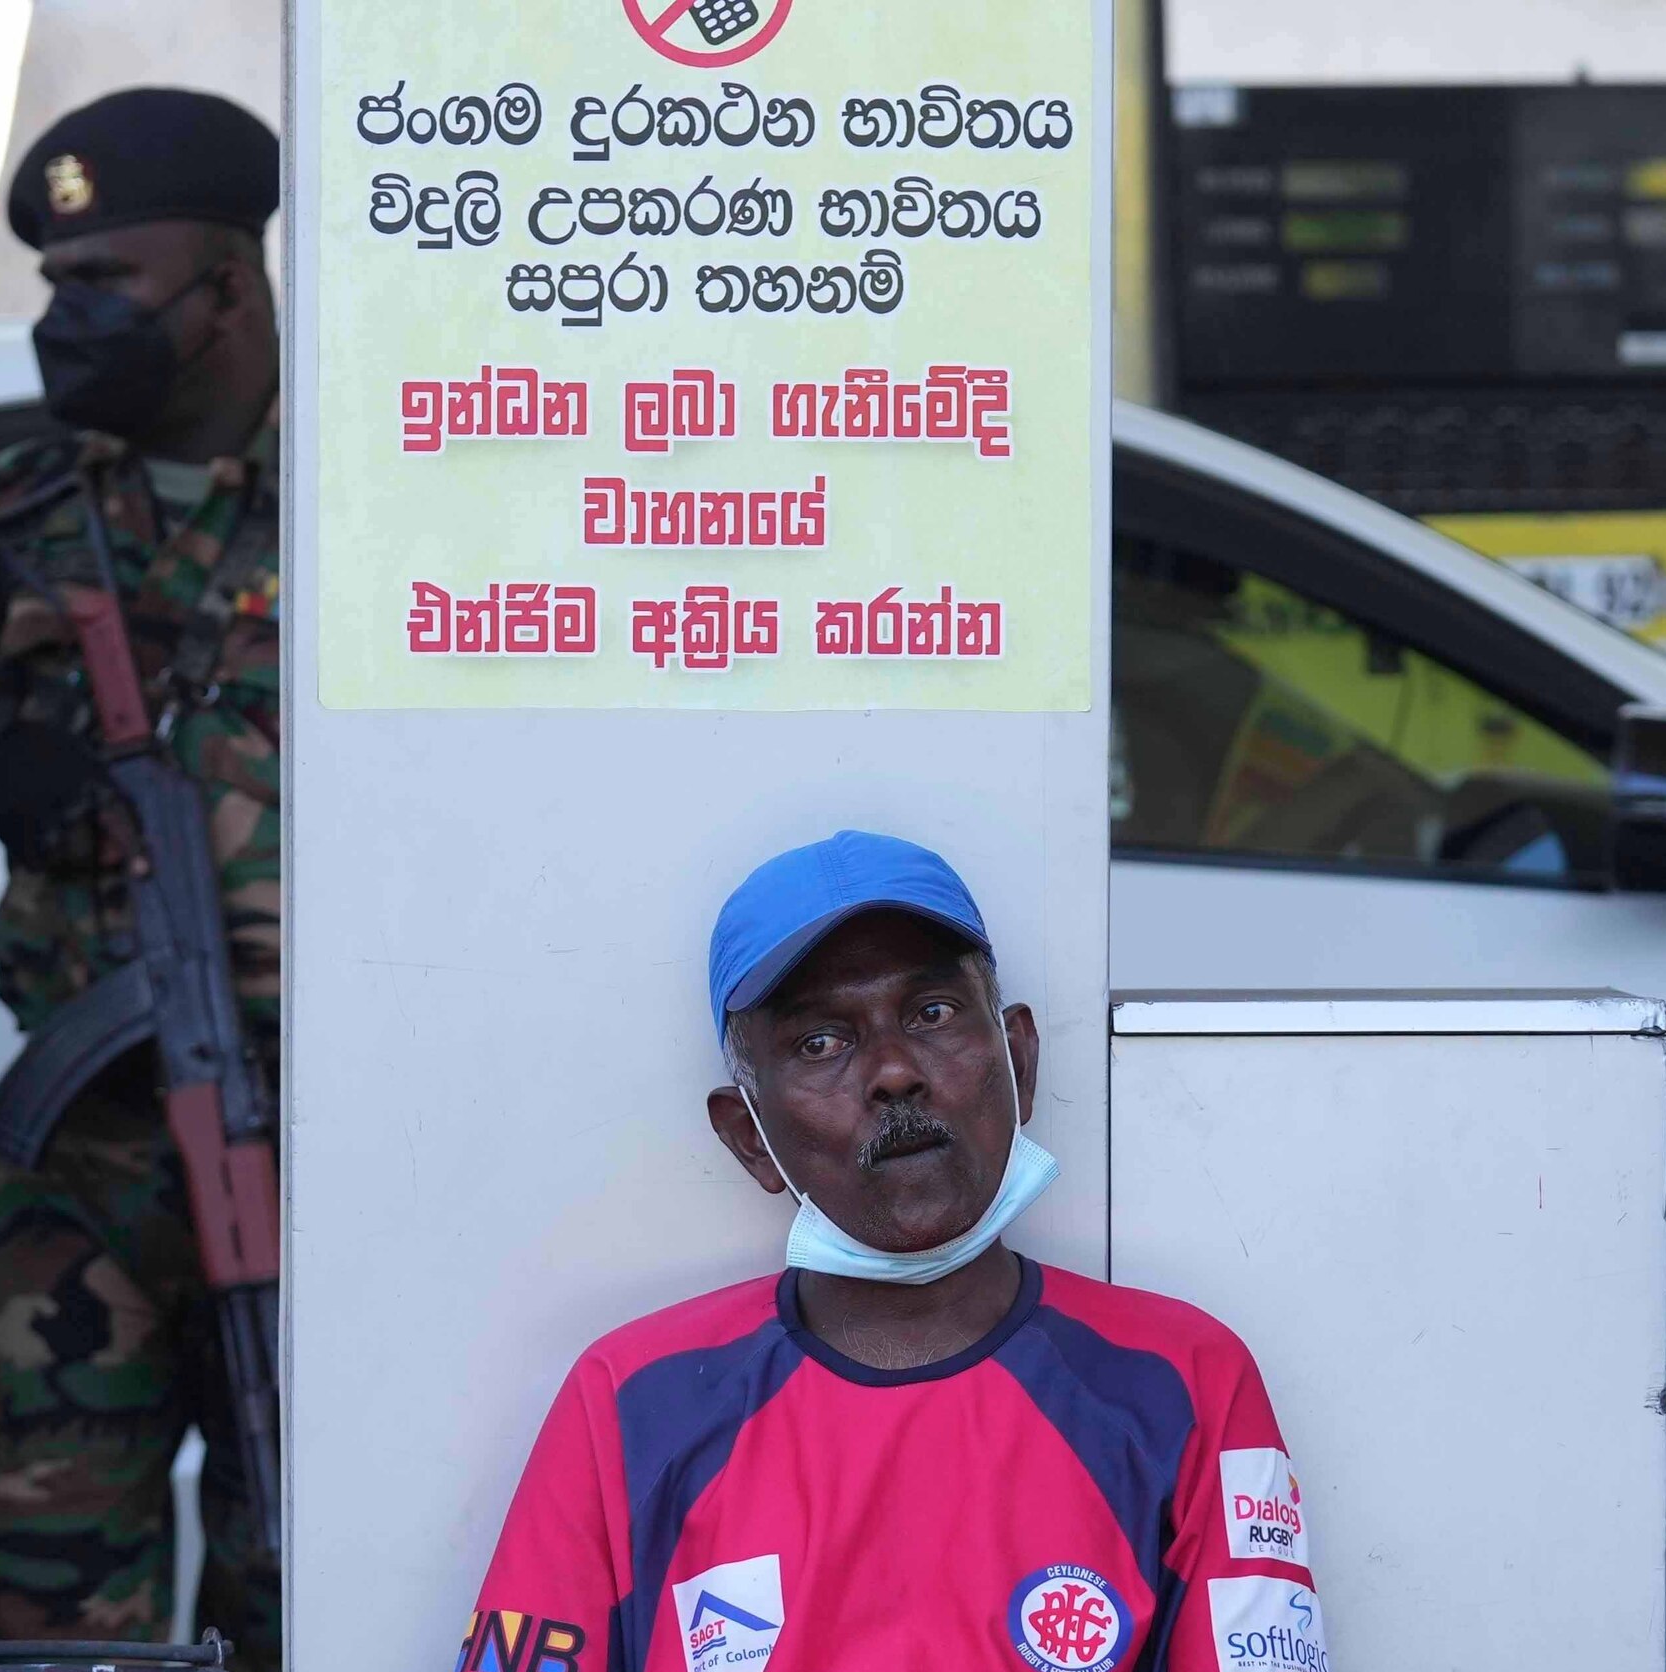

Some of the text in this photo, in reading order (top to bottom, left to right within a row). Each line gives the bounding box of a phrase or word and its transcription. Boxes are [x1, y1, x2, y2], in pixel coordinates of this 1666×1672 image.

[356, 81, 1073, 162] ජංගම දුරකථන භාවිතය
[368, 171, 1042, 250] විදුලි උපකරණ භාවිතය
[505, 249, 906, 327] සපුරා තහනම්
[401, 365, 588, 452] ඉන්ධන
[624, 369, 735, 452] ලබා
[584, 476, 826, 545] වාහනයේ
[816, 585, 1001, 655] කරන්න
[1234, 1495, 1301, 1534] Dialog
[1249, 1525, 1294, 1548] RUGBY
[1047, 1565, 1107, 1589] CEYLONESE
[690, 1620, 725, 1649] SAGT
[708, 1654, 719, 1668] of
[726, 1644, 774, 1663] Colom
[1017, 1642, 1042, 1669] RUGBY
